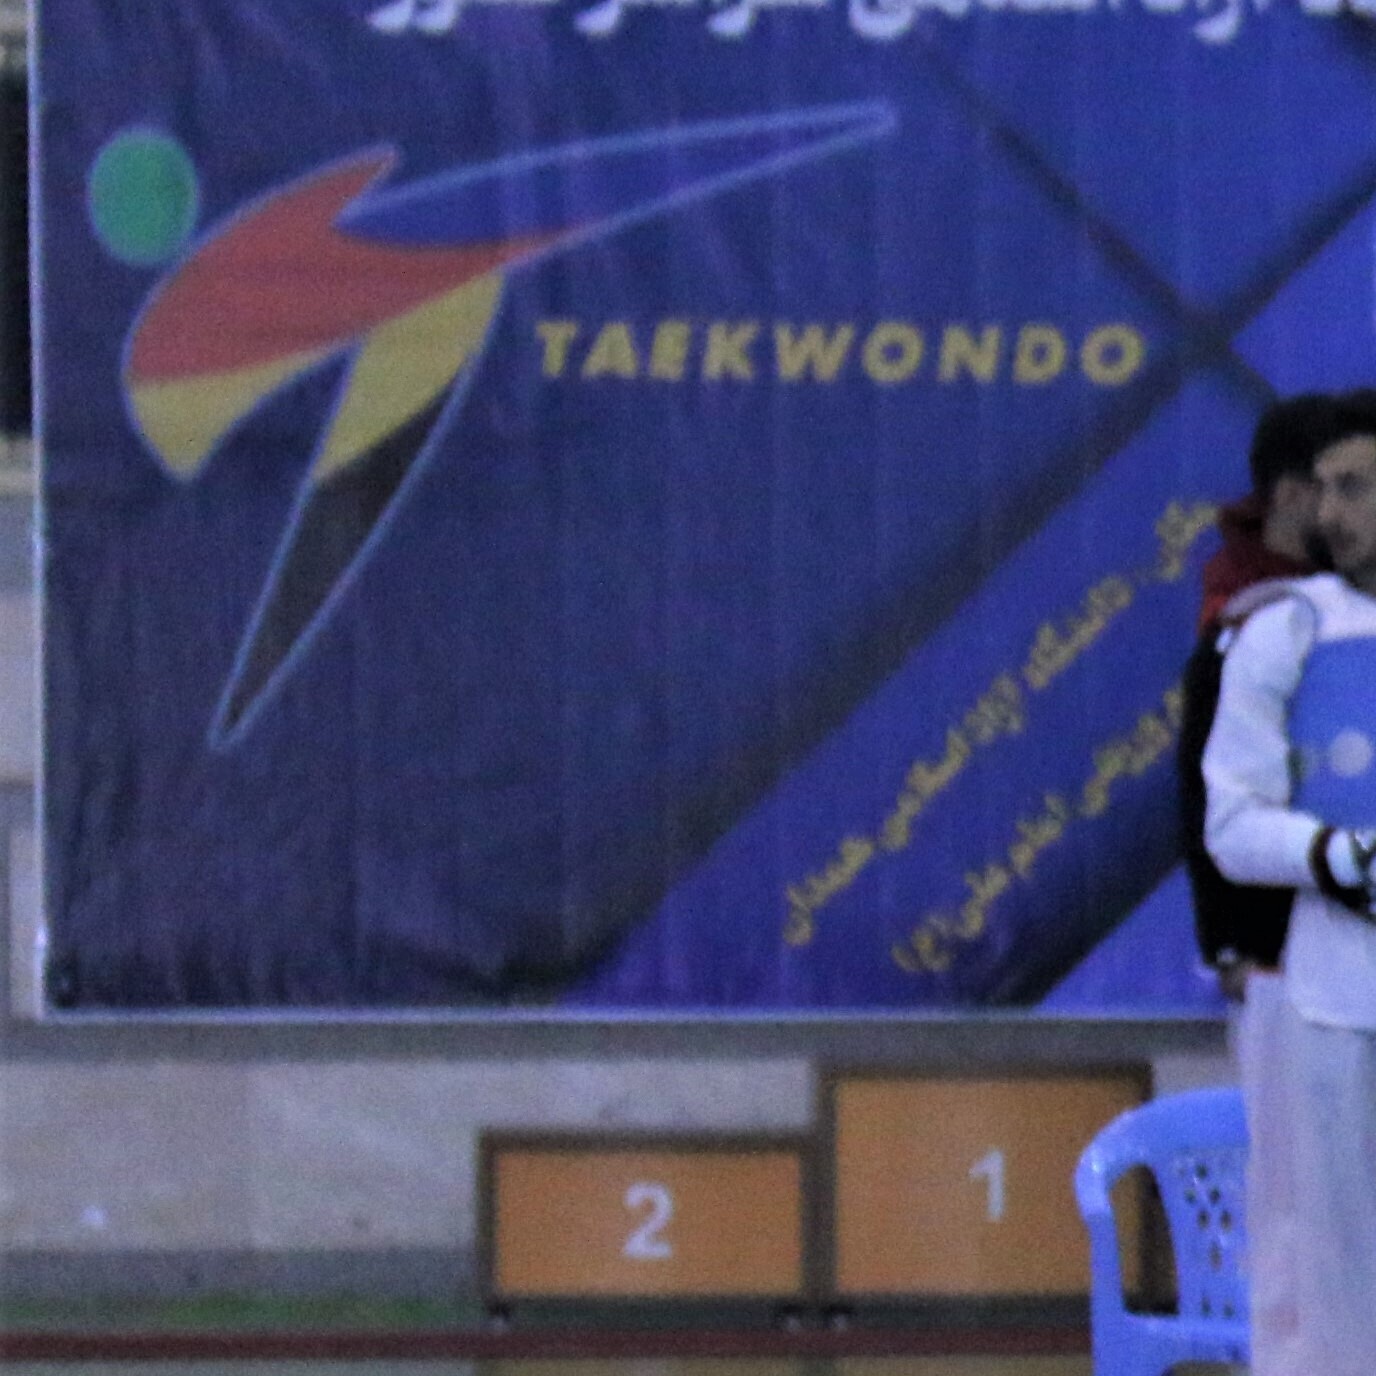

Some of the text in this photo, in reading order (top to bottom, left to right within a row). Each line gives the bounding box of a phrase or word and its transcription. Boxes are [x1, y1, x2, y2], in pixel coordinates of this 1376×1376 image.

[535, 320, 1145, 386] TAEKWONDO
[622, 1180, 675, 1259] 2
[969, 1149, 1006, 1223] 1
